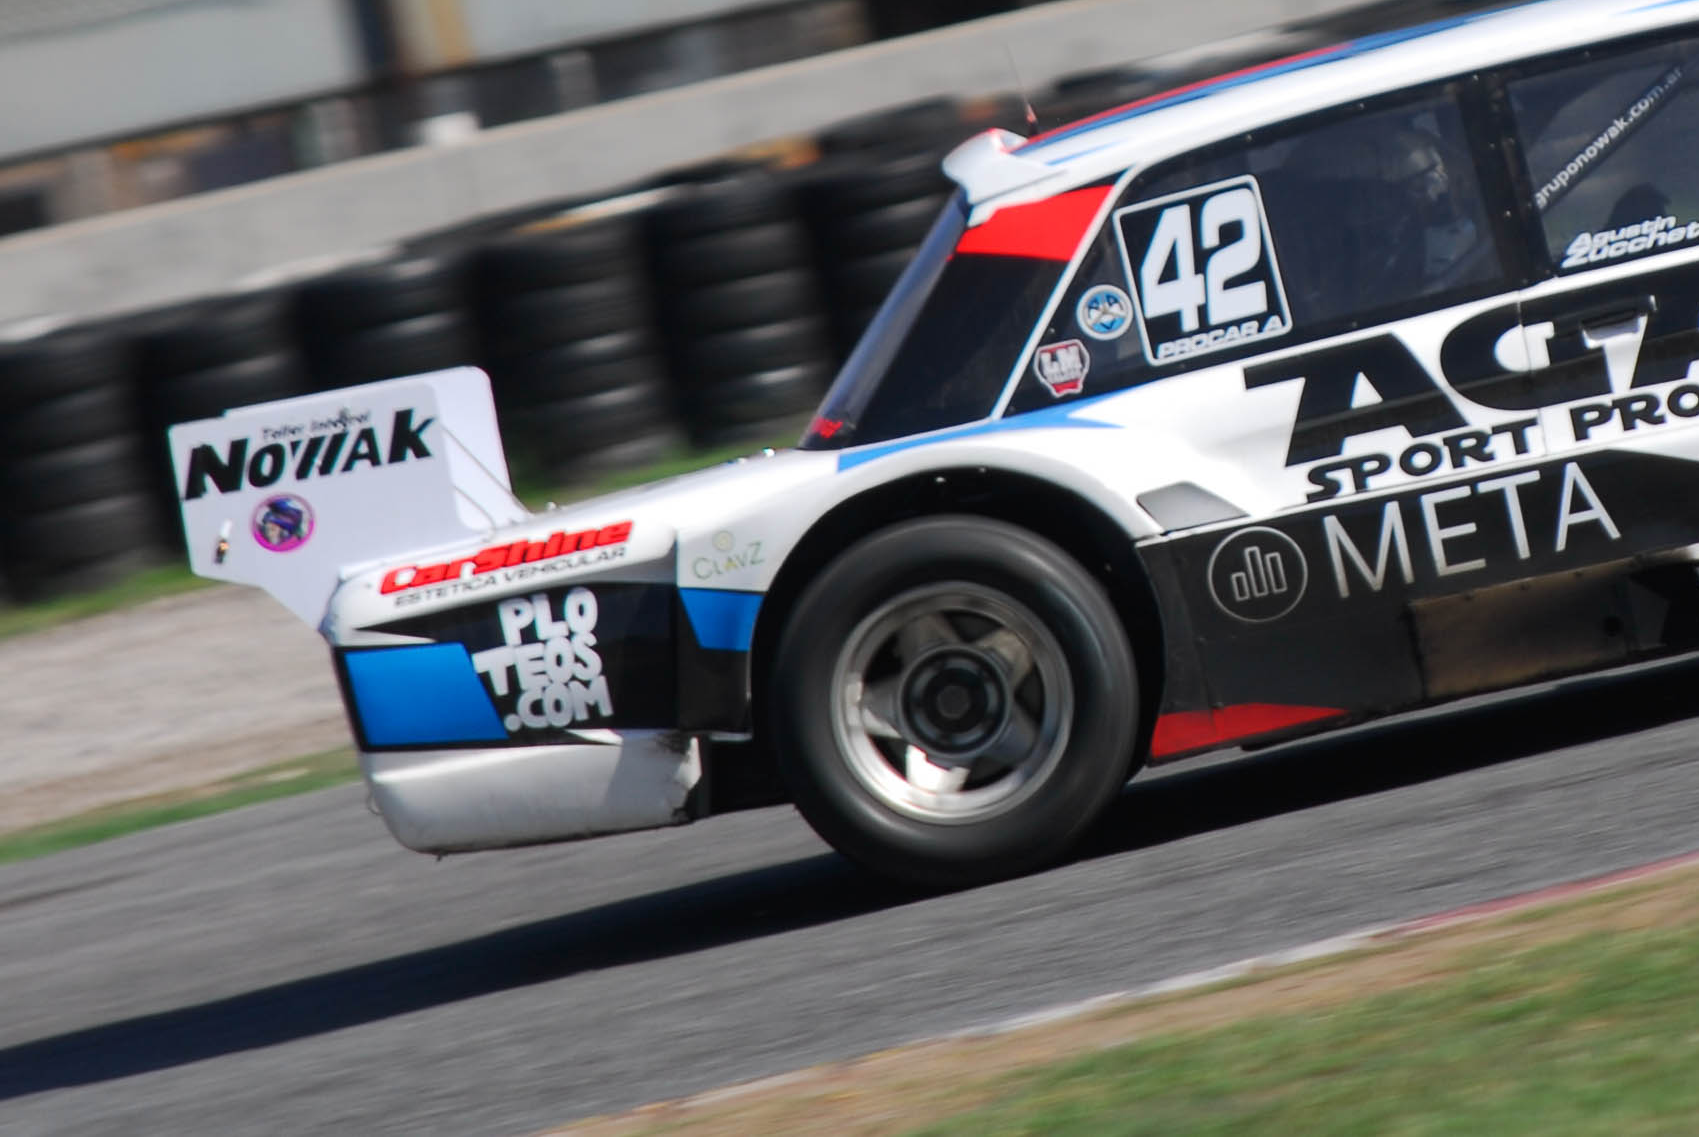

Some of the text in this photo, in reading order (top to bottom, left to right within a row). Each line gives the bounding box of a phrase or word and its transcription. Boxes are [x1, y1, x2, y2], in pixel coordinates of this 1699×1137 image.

[1141, 187, 1268, 333] 42
[1566, 216, 1676, 255] Agustin
[1157, 315, 1285, 360] PROCAR A
[1305, 417, 1540, 503] SPORT
[1323, 462, 1622, 599] META
[498, 587, 598, 646] PLO
[504, 675, 614, 732] .COM
